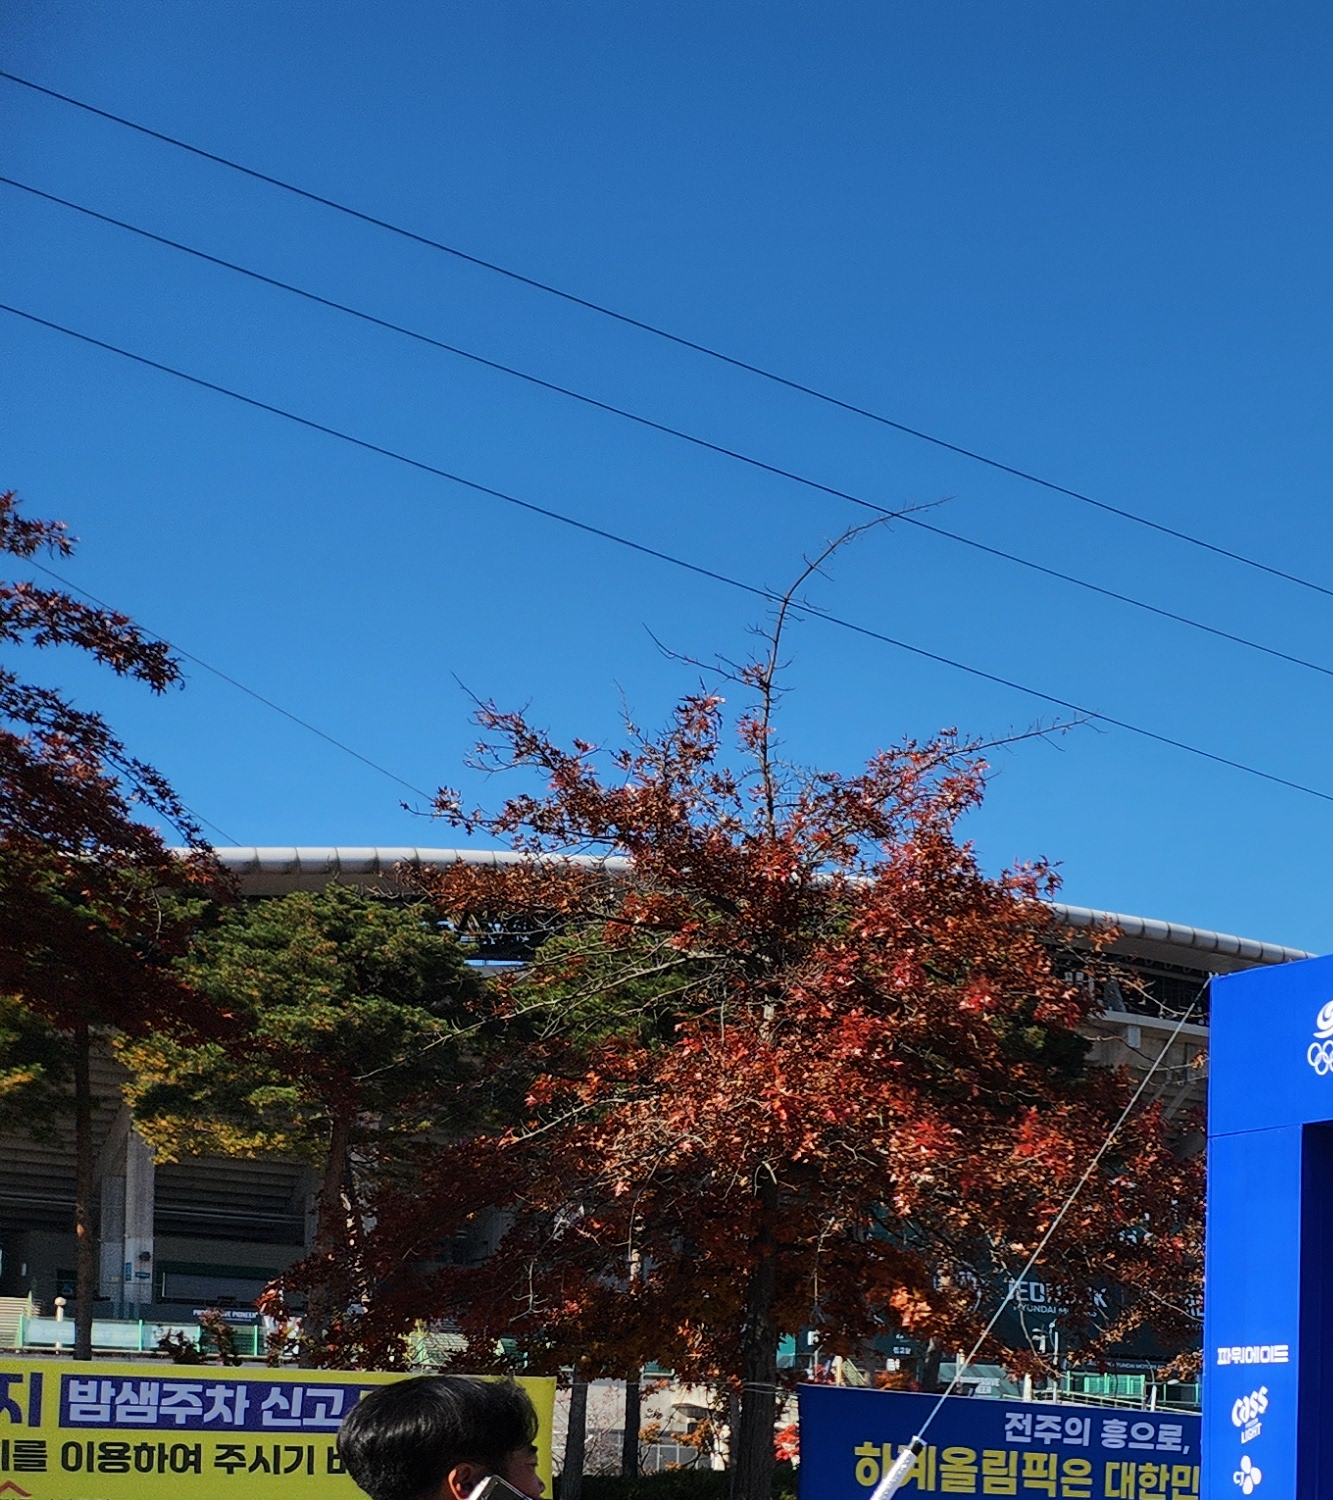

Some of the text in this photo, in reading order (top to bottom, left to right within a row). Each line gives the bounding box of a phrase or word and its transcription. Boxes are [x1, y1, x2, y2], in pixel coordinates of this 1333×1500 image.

[1217, 1344, 1289, 1365] 파워에이드
[68, 1380, 250, 1426] 밤샘주차
[261, 1386, 345, 1427] 신고
[1004, 1412, 1190, 1455] 전주의 흥으로,
[60, 1440, 202, 1474] 이용하여
[214, 1444, 314, 1475] 주시기
